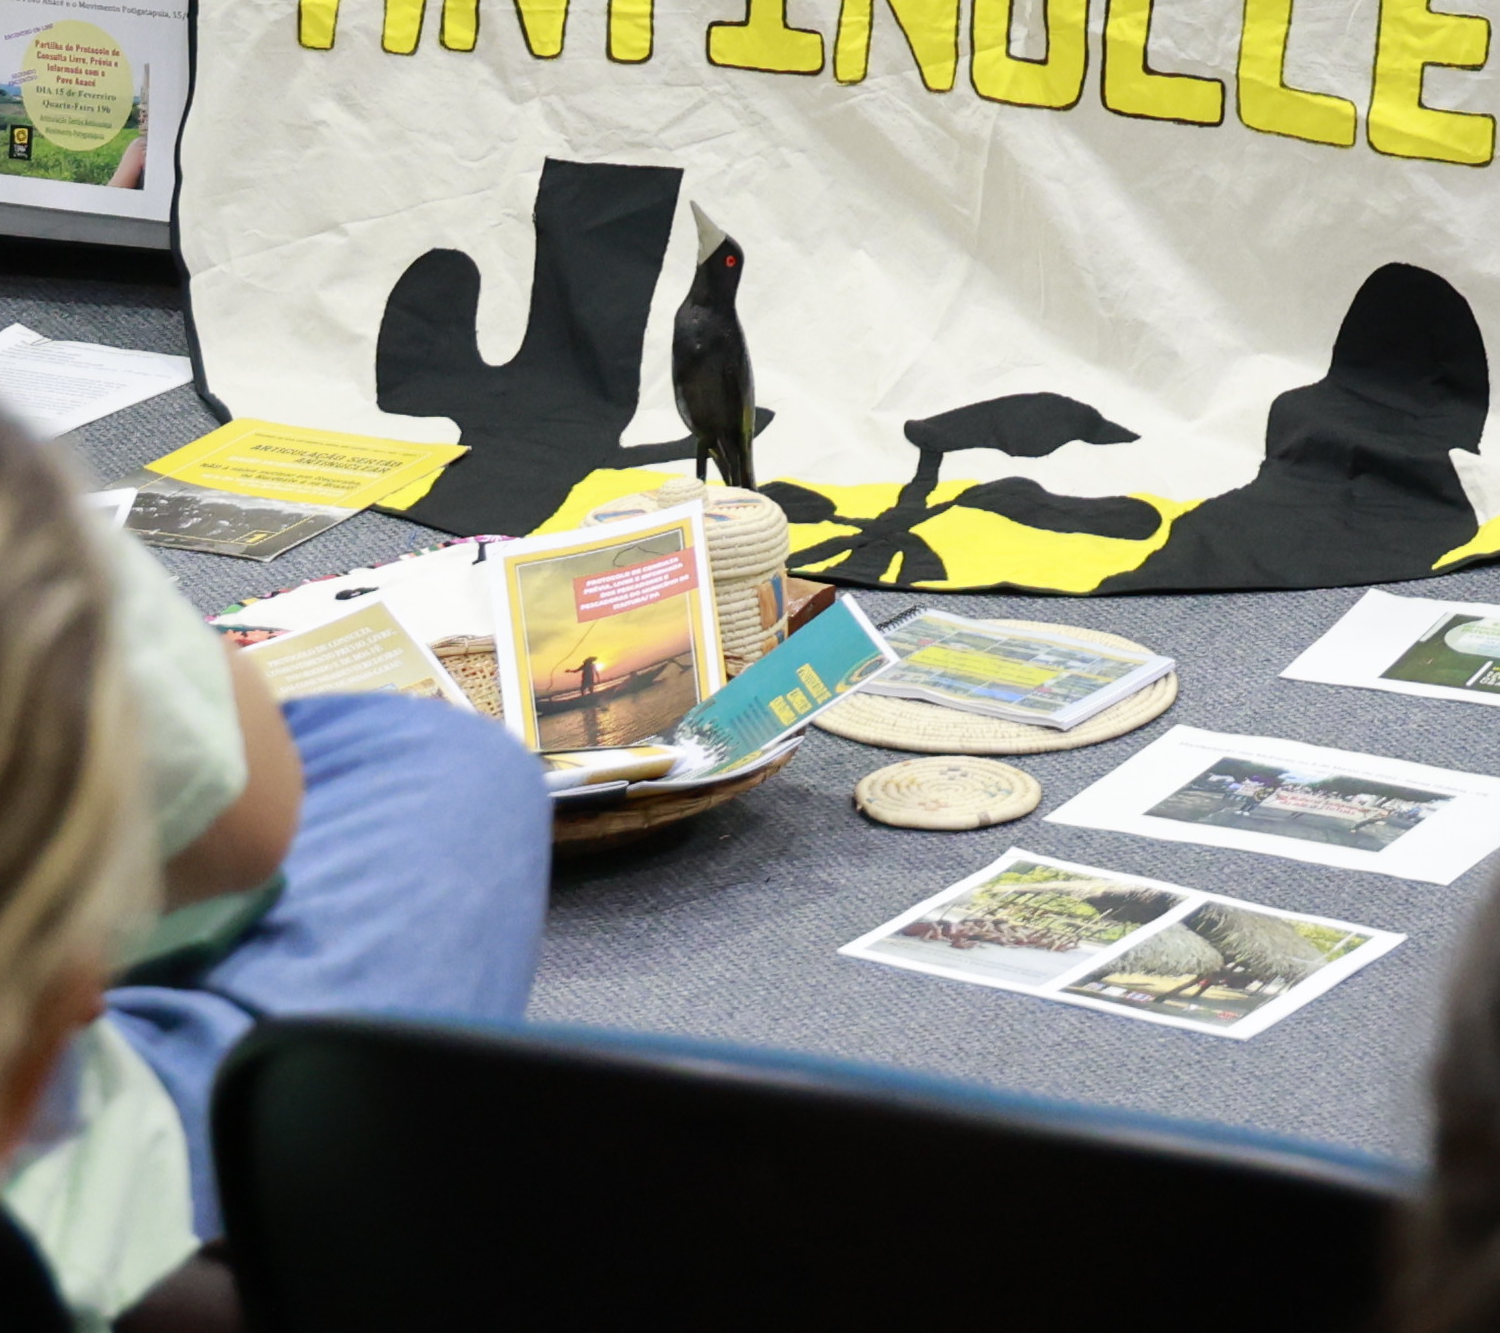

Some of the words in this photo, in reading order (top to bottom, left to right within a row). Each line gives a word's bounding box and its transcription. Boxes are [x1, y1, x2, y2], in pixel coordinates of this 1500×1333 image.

[78, 1, 121, 13] Movimento
[35, 39, 63, 51] Partilha
[76, 45, 109, 56] Protocolo
[36, 51, 67, 62] Consulta
[90, 56, 112, 67] Prévia
[47, 63, 83, 75] Informada
[85, 68, 99, 77] com
[56, 75, 73, 86] Povo
[35, 85, 52, 95] DIA
[55, 87, 64, 96] 15
[66, 88, 76, 97] de
[77, 89, 117, 102] Fevereiro
[97, 104, 112, 114] 19h
[250, 443, 347, 462] ARTICULAÇÃO
[349, 453, 404, 468] SERTÃO
[293, 456, 391, 475] ANTINUCLEAR
[586, 571, 630, 586] PROTOCOLO
[642, 556, 680, 572] CONSULTA
